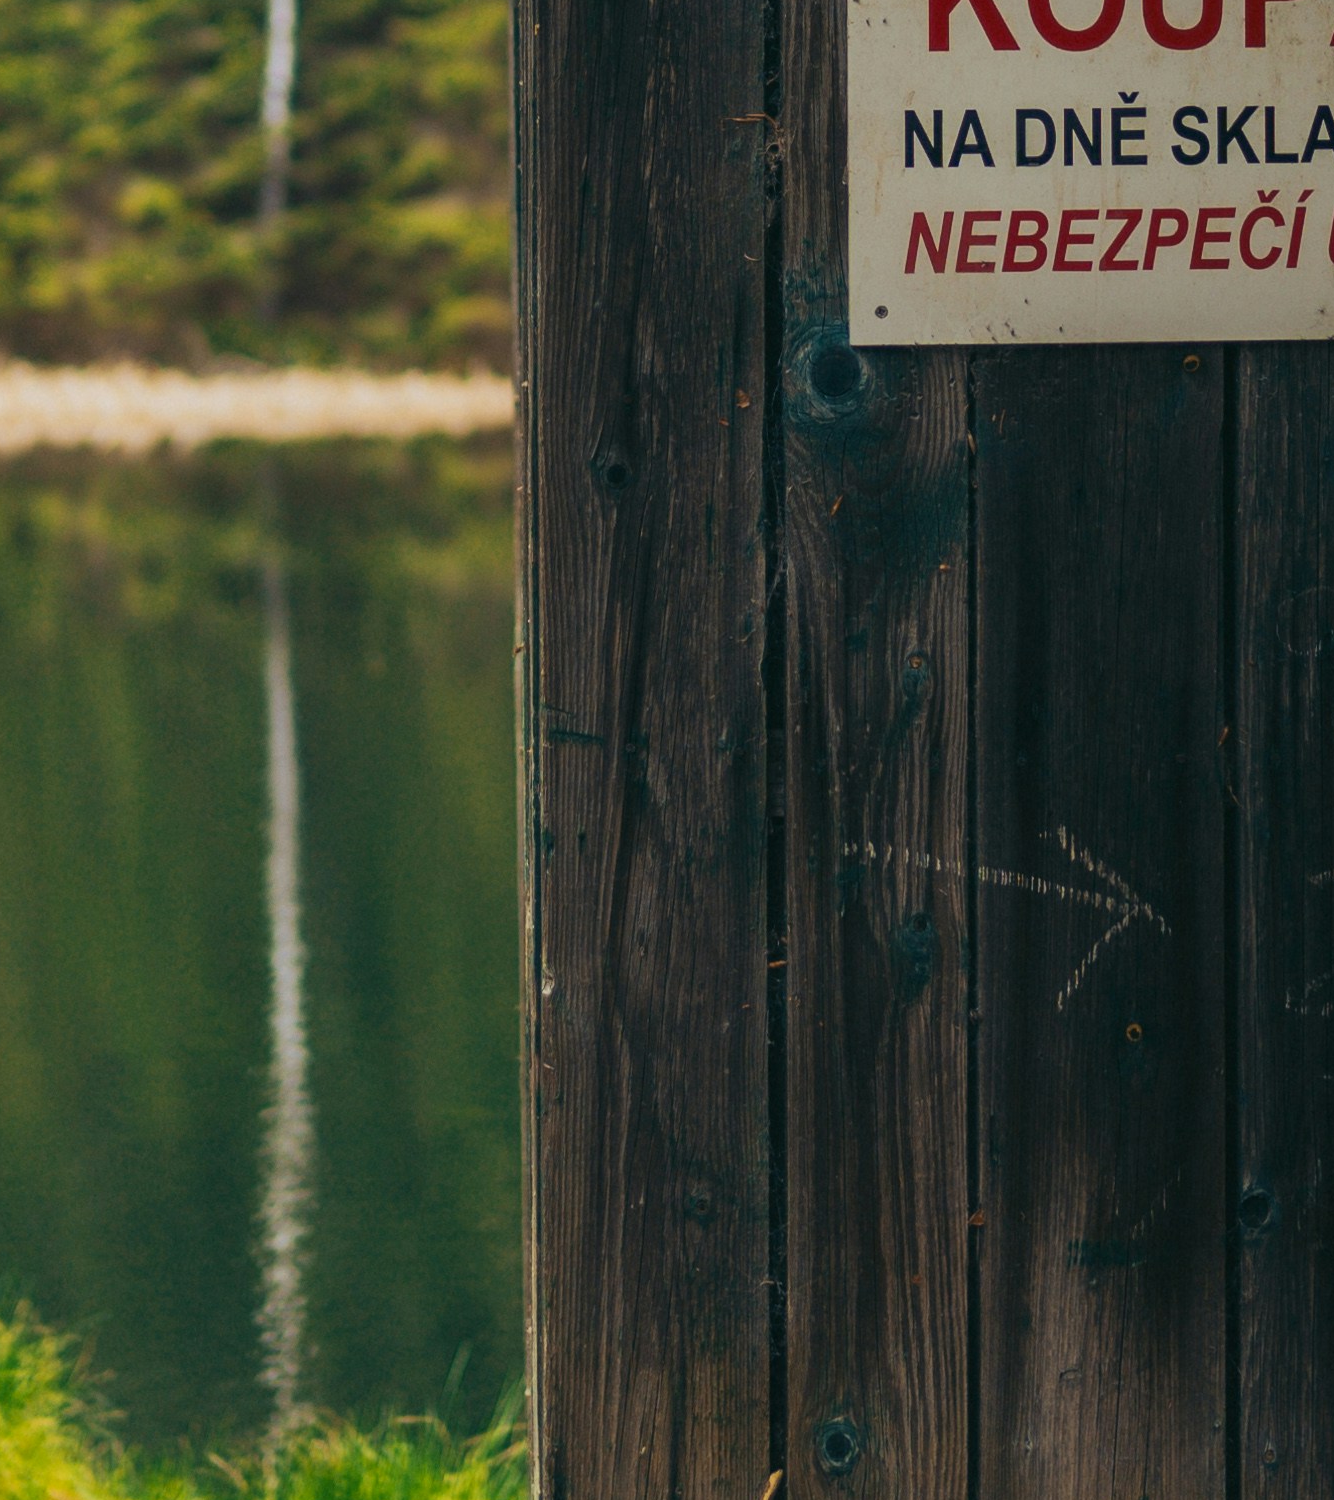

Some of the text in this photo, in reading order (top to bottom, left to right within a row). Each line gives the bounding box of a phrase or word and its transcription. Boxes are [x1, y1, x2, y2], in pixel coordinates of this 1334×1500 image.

[904, 109, 996, 168] NA
[1015, 91, 1149, 167] DNĚ
[904, 189, 1313, 274] NEBEZPEČÍ
